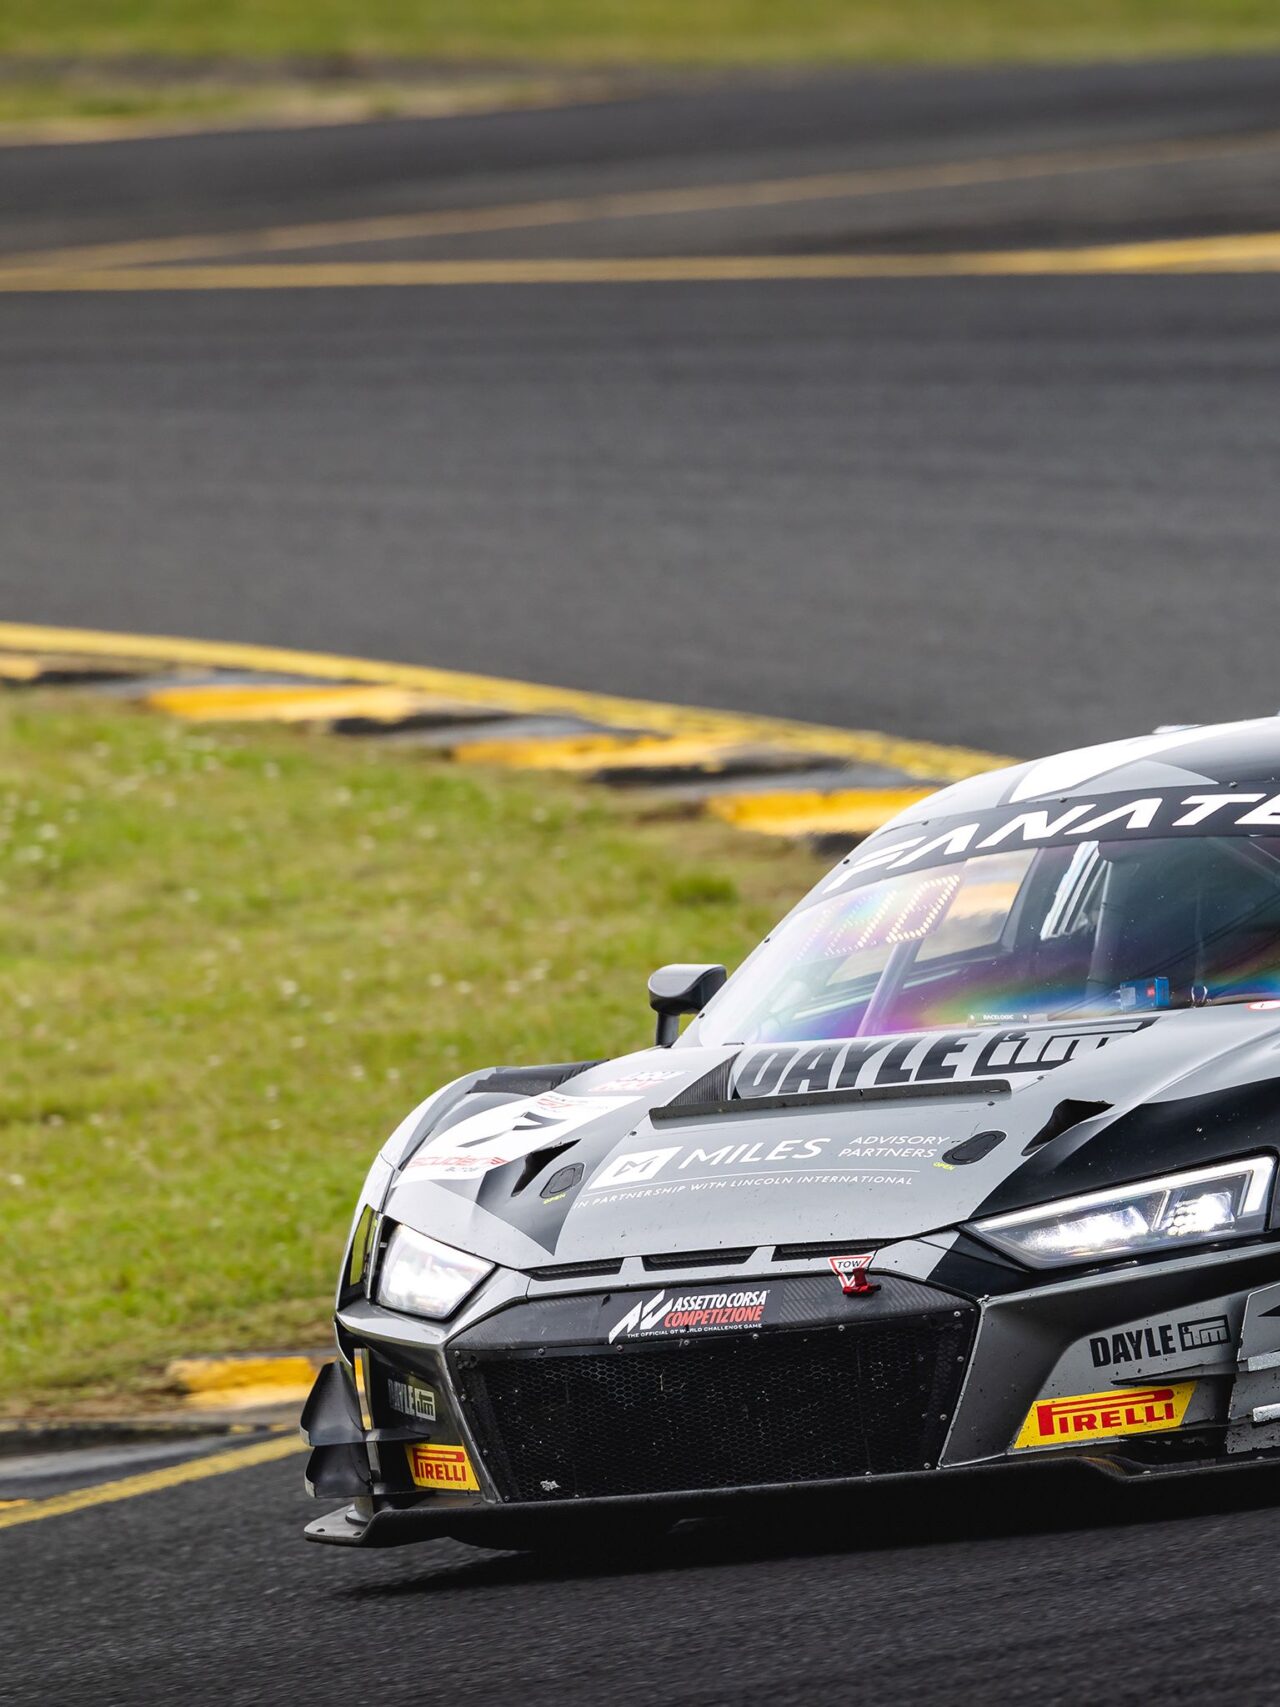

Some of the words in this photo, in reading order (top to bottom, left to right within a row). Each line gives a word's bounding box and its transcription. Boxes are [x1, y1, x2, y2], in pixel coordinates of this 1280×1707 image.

[734, 1031, 982, 1098] DAYLE
[678, 1138, 832, 1170] MILES
[838, 1147, 938, 1161] PARTNERS
[849, 1135, 951, 1146] ADVISORY
[574, 1200, 591, 1209] IN
[592, 1184, 687, 1206] PARTNERSHIP
[690, 1179, 727, 1191] WITH
[730, 1176, 793, 1188] LINCOLN
[795, 1175, 914, 1186] INTERNATIONAL
[836, 1258, 863, 1269] TOW
[671, 1293, 726, 1312] ASSETTO
[726, 1290, 767, 1307] CORSA
[664, 1305, 765, 1328] COMPETIZIONE
[680, 1326, 703, 1334] WRLD
[703, 1324, 742, 1332] CHALLENGE
[1089, 1324, 1177, 1367] DAYLE
[1036, 1388, 1175, 1436] PIRELLI
[412, 1447, 467, 1482] PIRELLI
